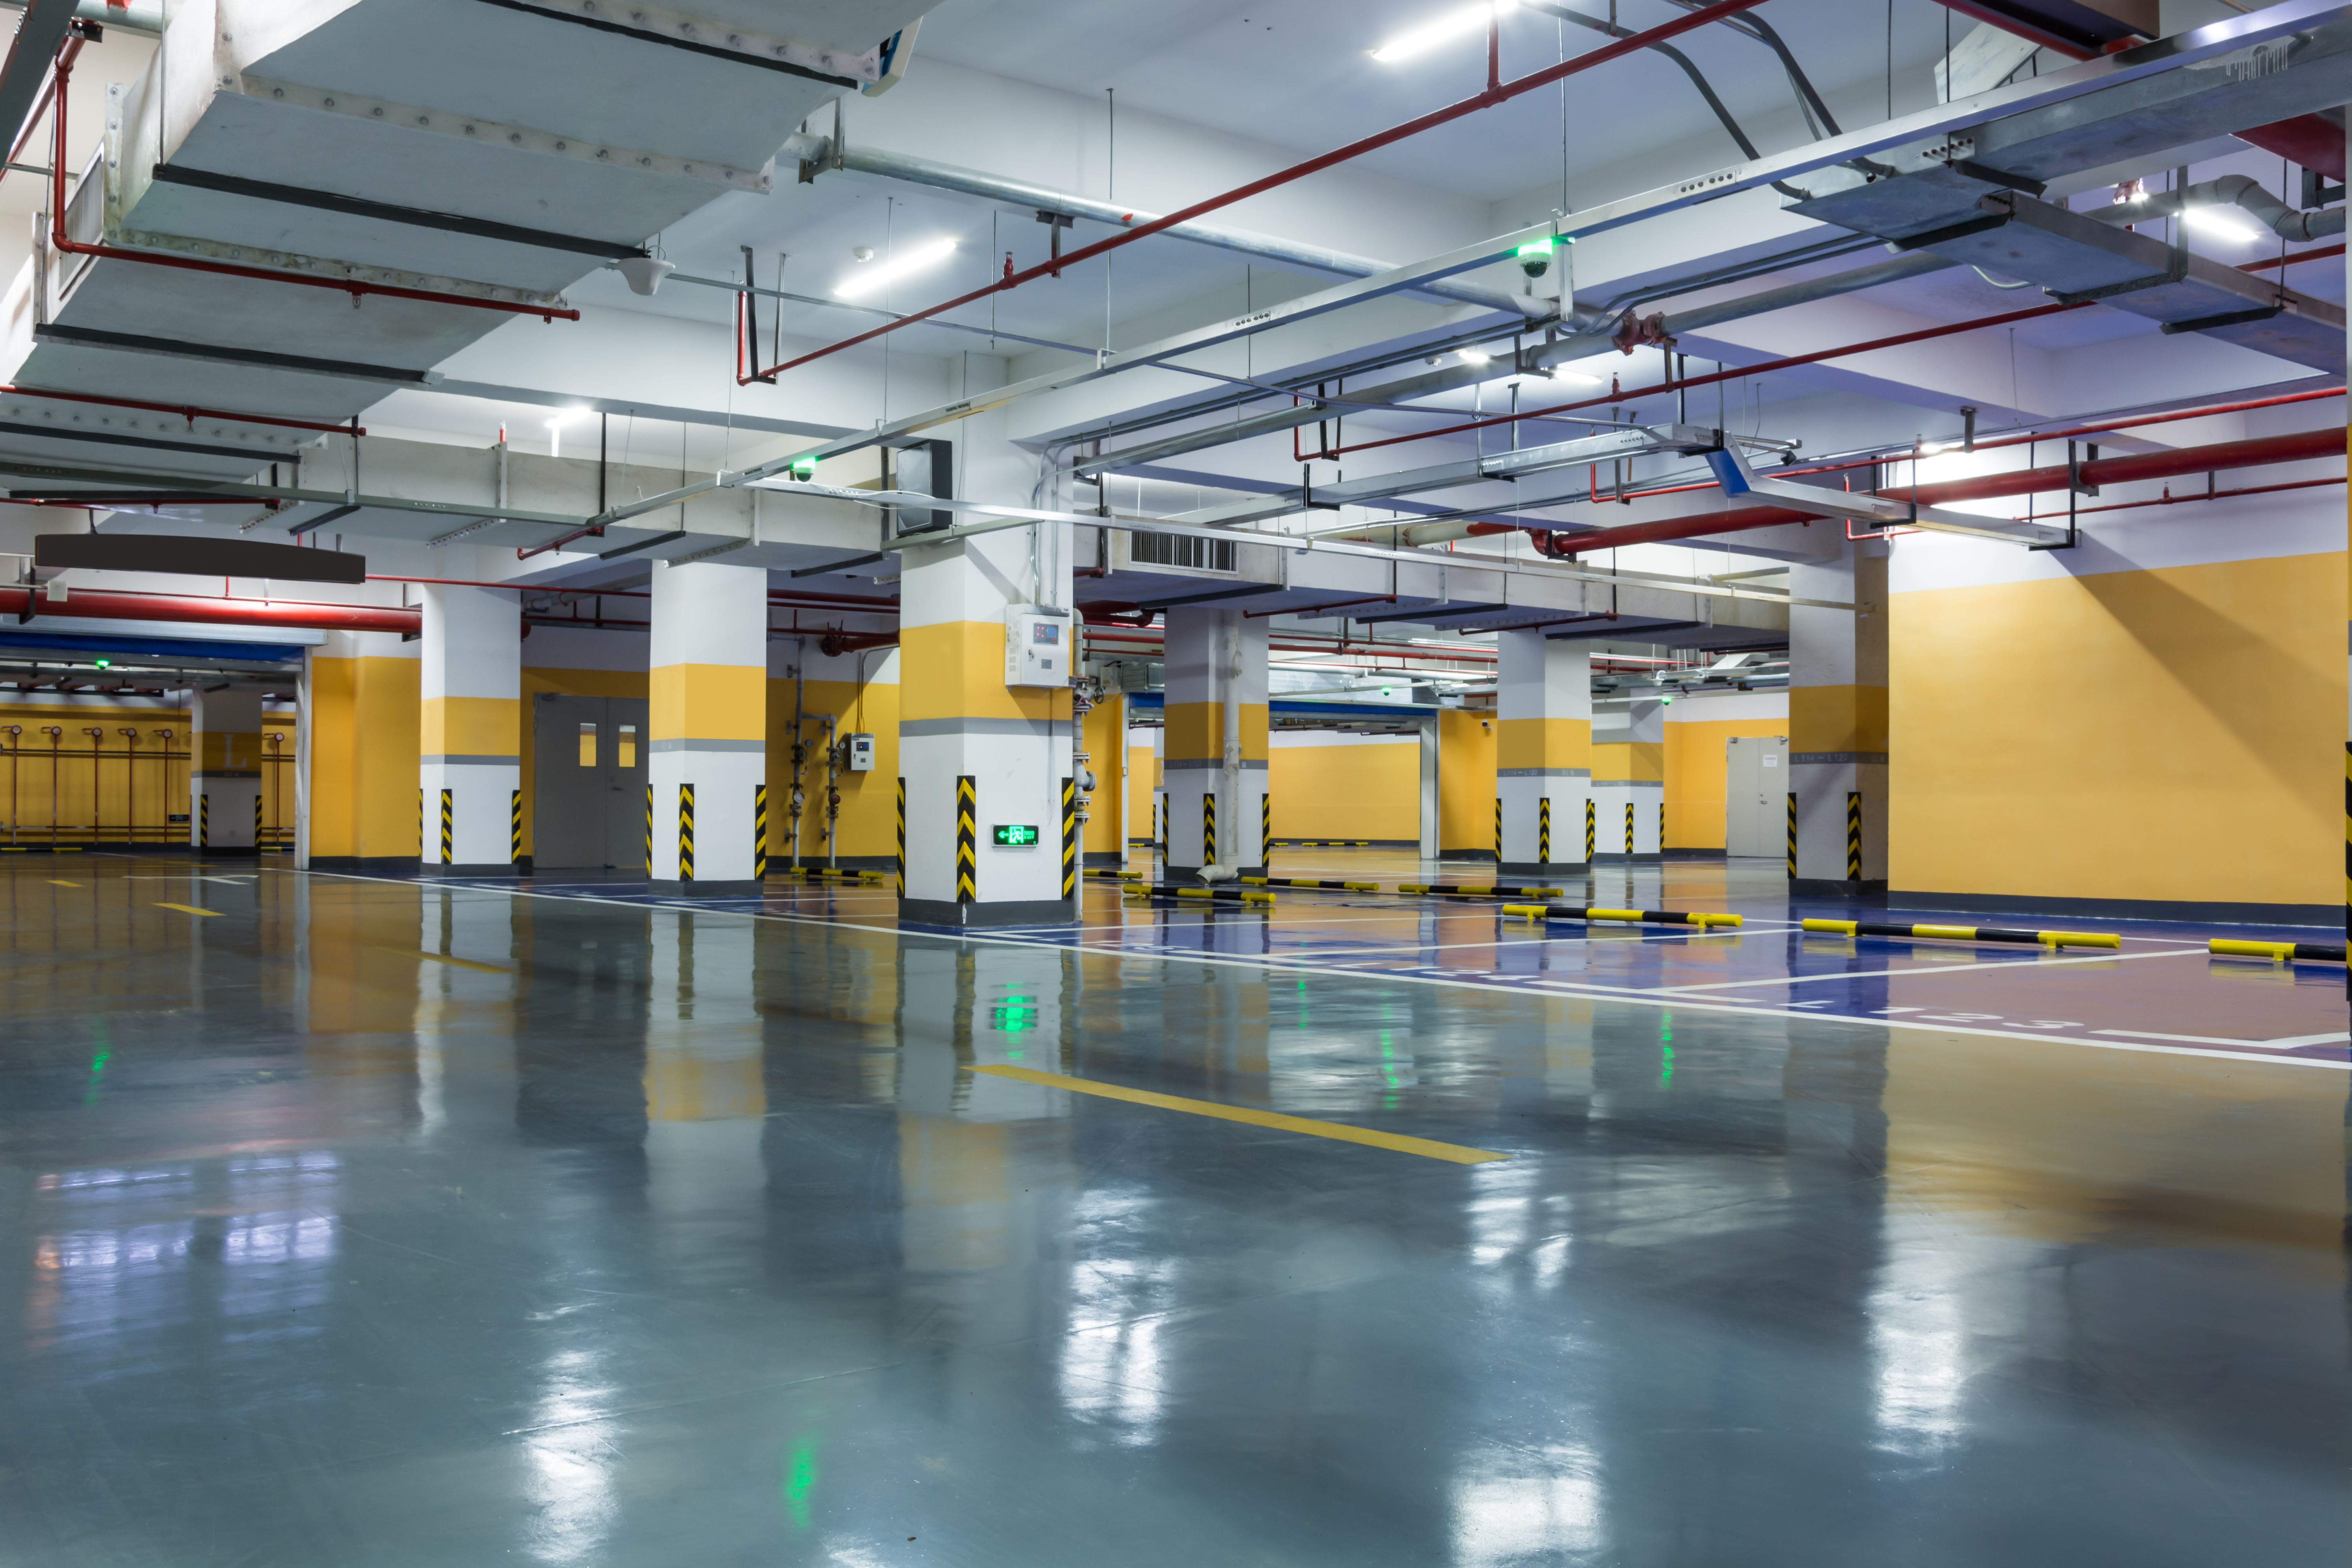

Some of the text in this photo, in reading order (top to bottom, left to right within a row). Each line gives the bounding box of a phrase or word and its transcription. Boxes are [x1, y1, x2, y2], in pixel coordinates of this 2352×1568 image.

[223, 734, 248, 769] L
[1828, 752, 1848, 761] L122
[1776, 1000, 2085, 1029] L123
